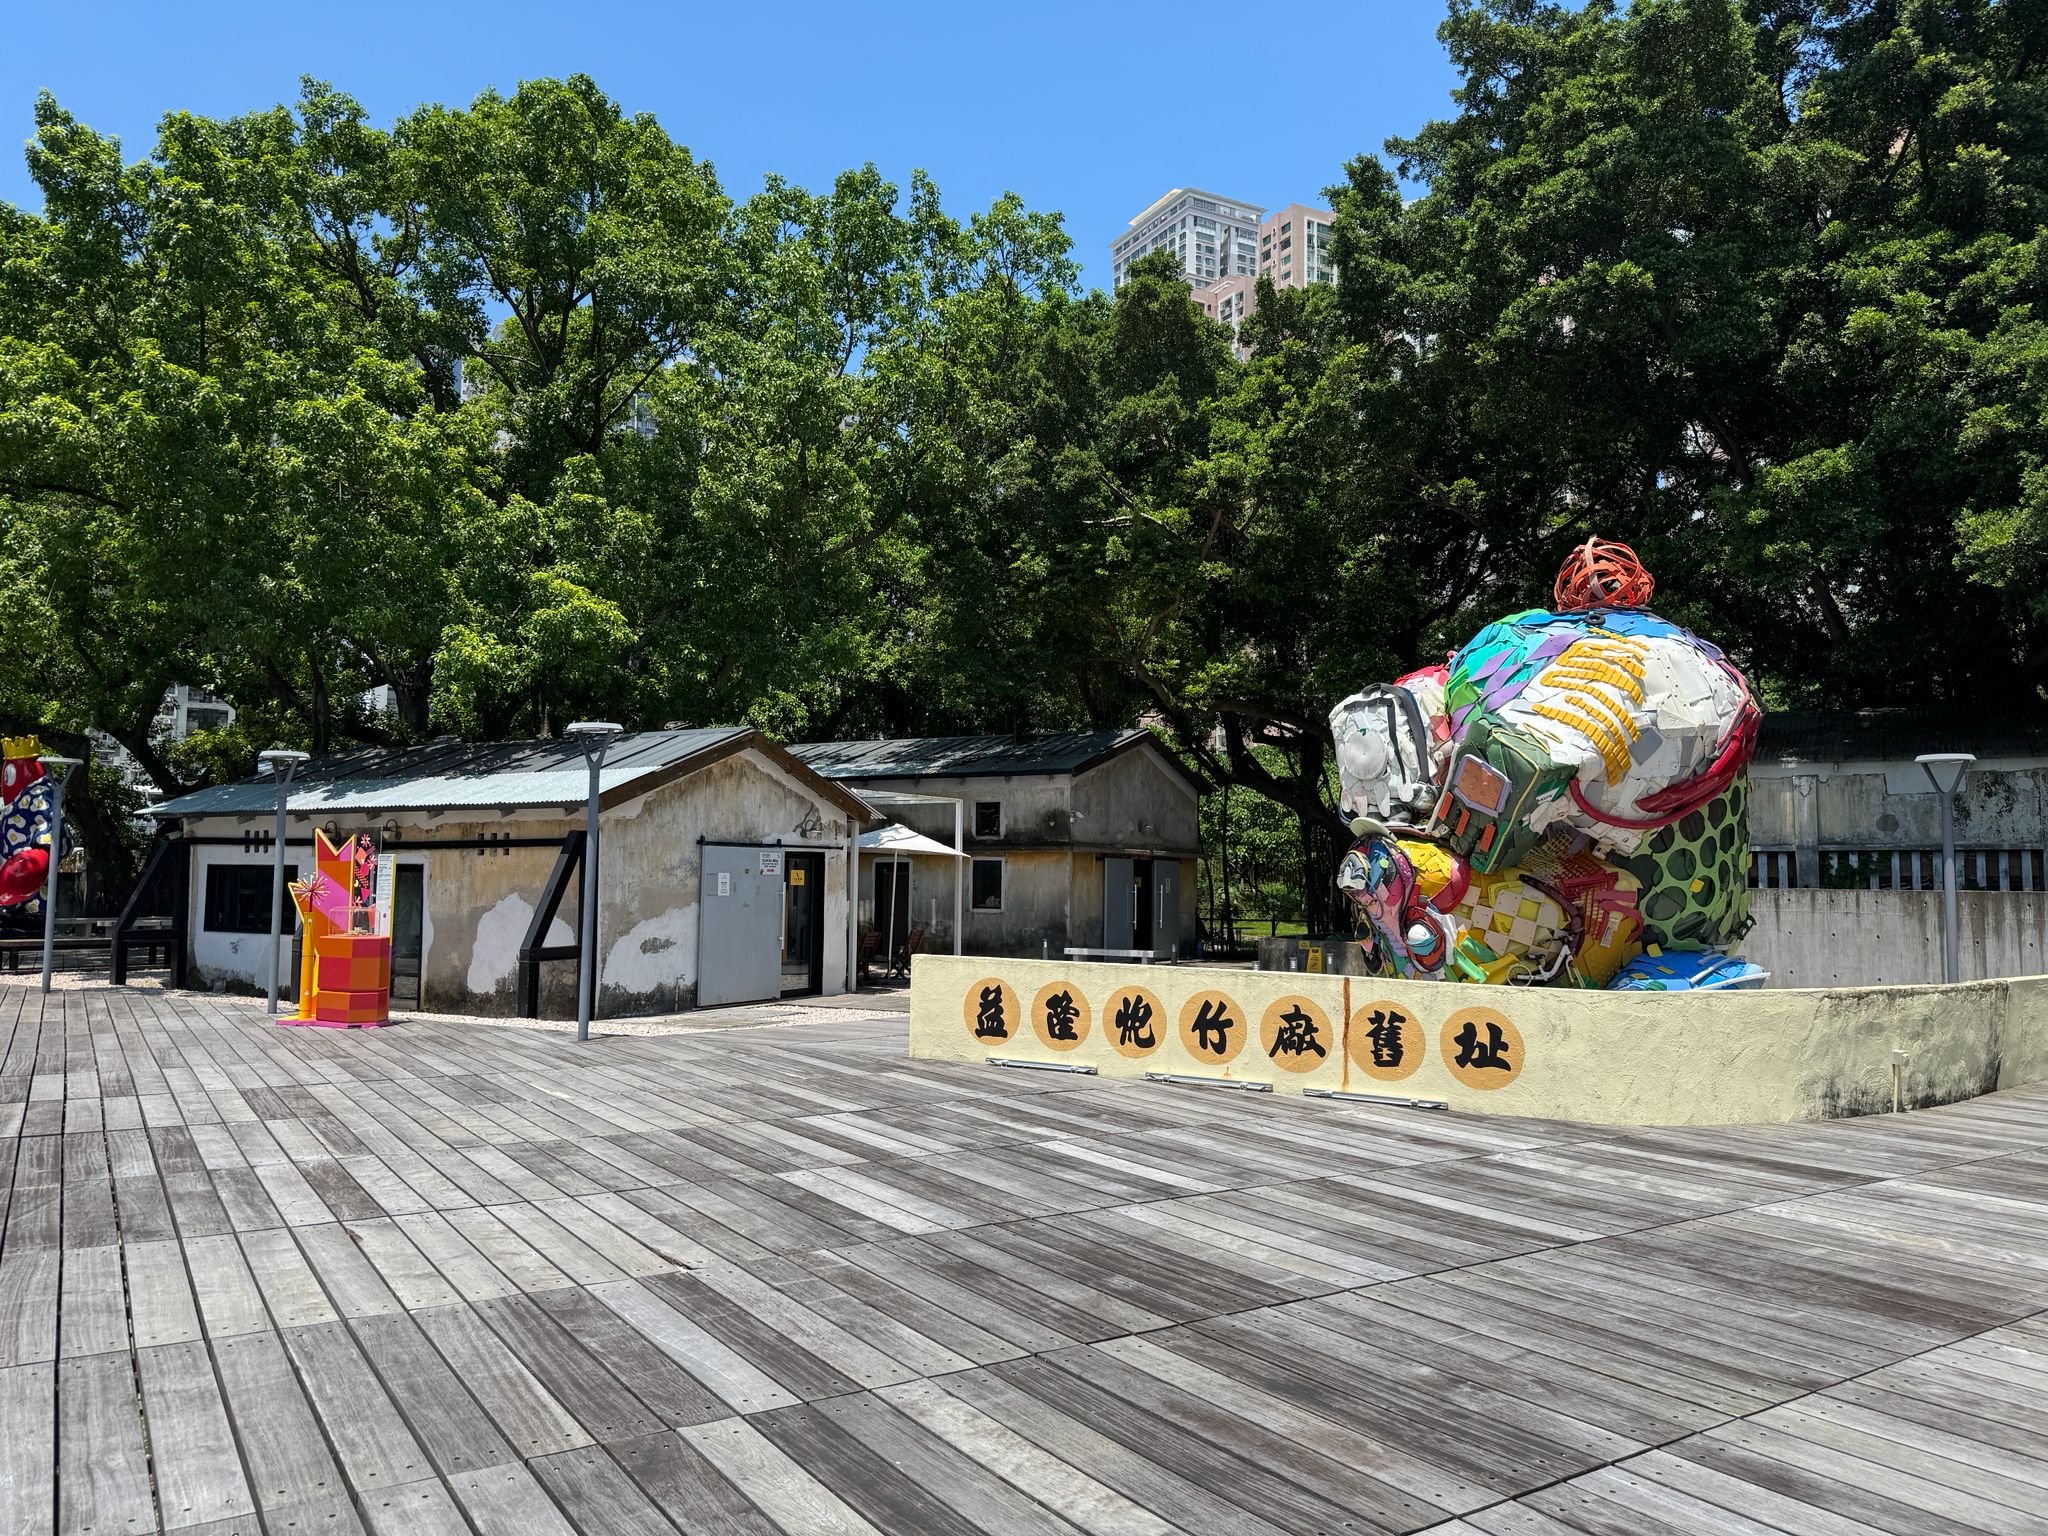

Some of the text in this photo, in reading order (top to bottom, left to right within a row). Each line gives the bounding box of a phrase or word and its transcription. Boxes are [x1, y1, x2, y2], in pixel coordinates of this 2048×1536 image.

[975, 984, 1512, 1072] 益隆炮竹廠舊址
